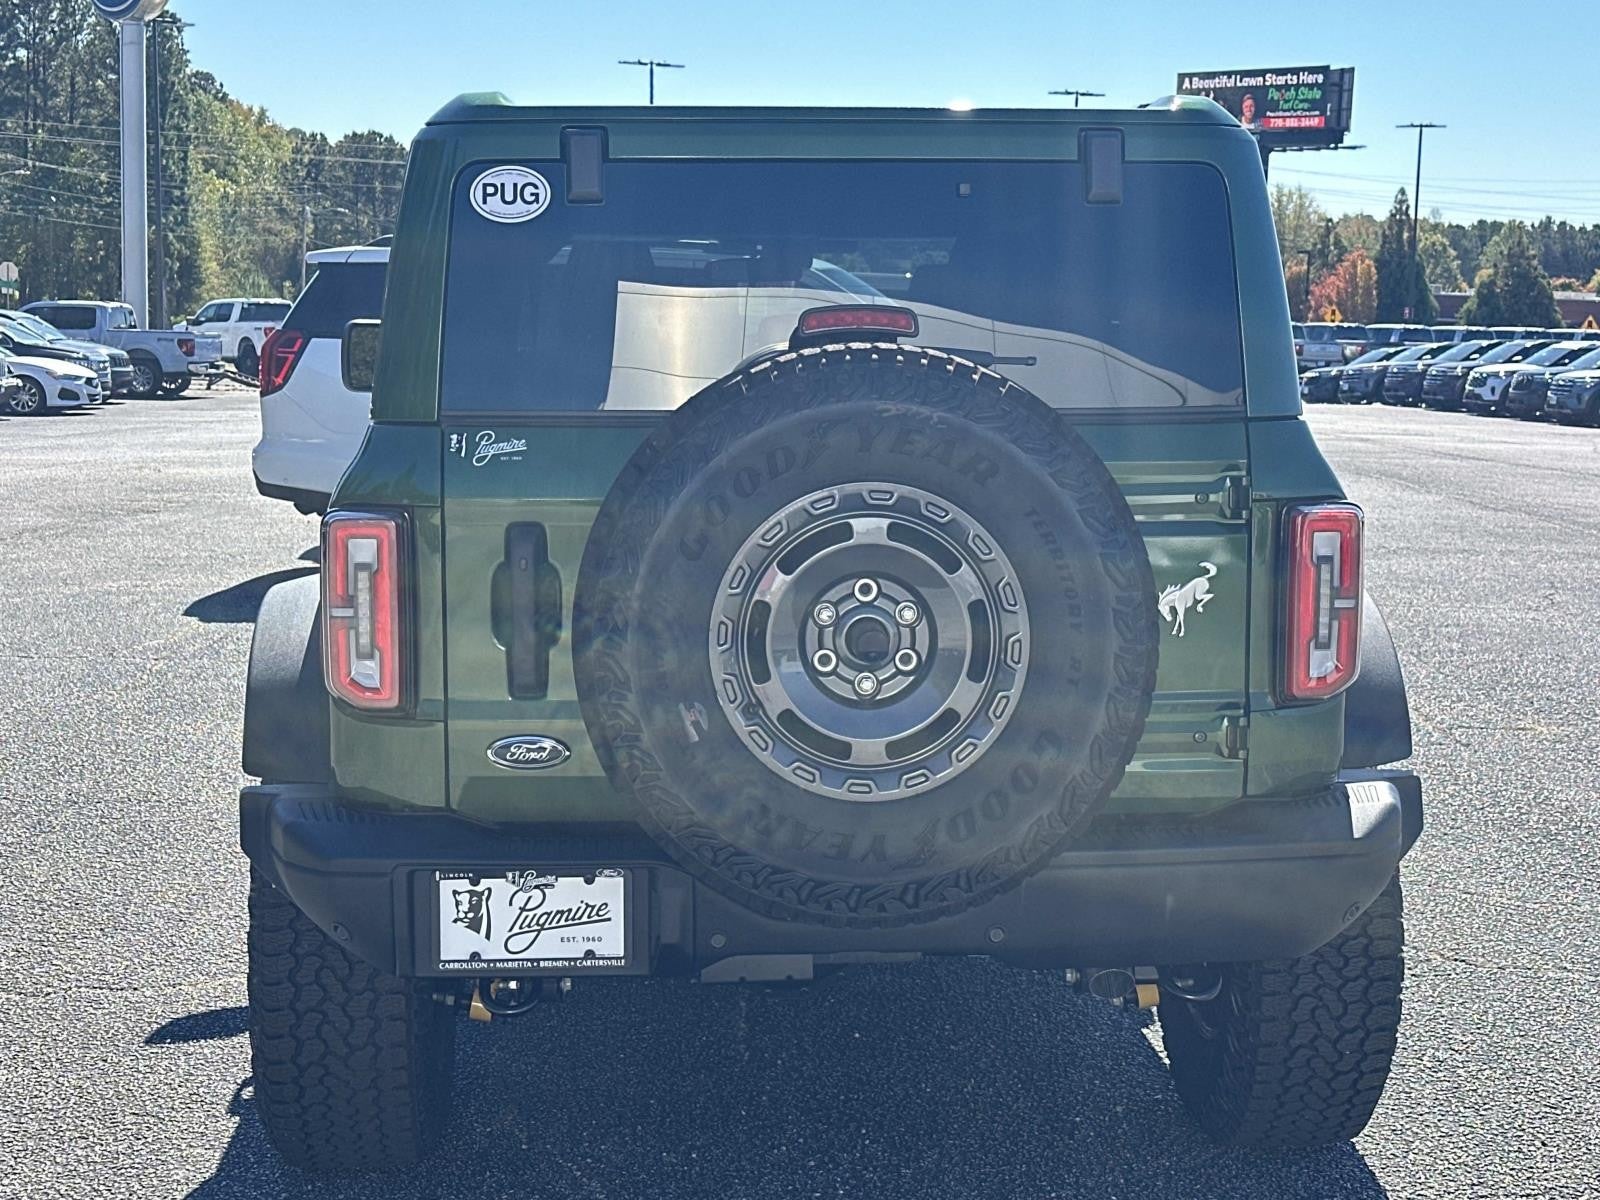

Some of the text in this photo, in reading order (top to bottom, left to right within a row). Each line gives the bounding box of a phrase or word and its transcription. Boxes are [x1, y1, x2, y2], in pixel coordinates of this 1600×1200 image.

[1182, 71, 1324, 90] A Beautiful Lawn Starts Here
[481, 182, 540, 205] PUG
[472, 430, 527, 466] Pugmire
[506, 742, 553, 761] Ford
[503, 887, 612, 955] Pugmire
[439, 962, 488, 970] CARROLLTON
[540, 960, 569, 968] BREMEN
[576, 959, 625, 967] CARTERSVILLE
